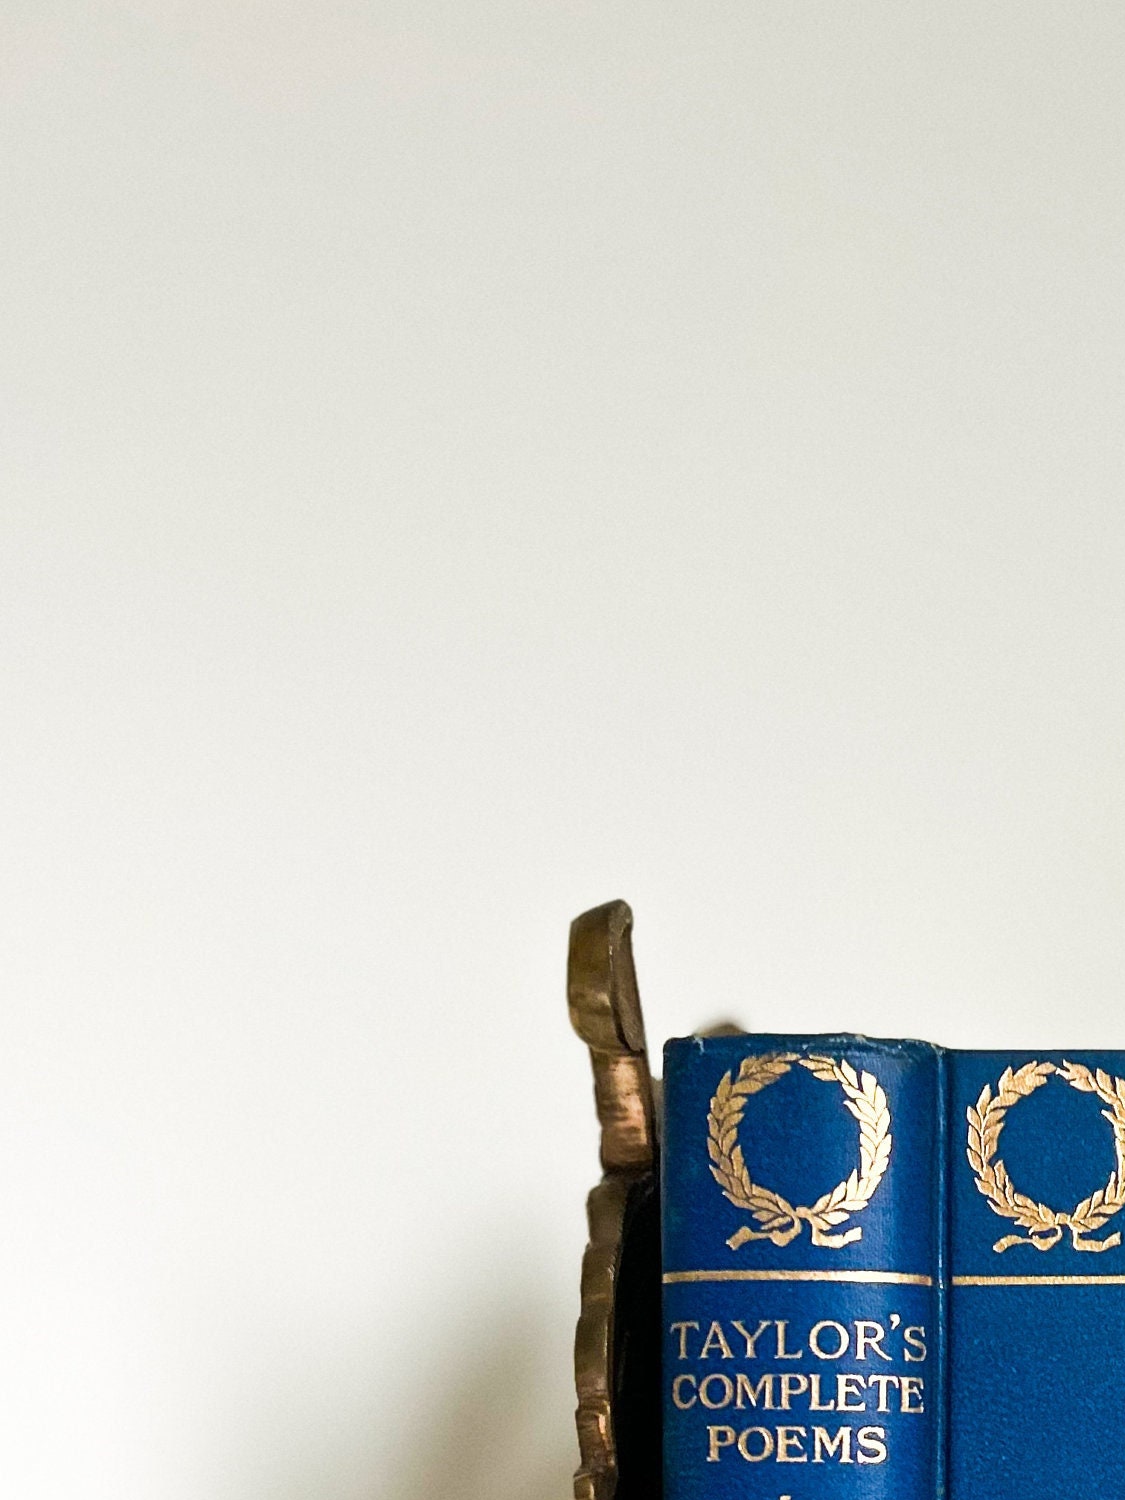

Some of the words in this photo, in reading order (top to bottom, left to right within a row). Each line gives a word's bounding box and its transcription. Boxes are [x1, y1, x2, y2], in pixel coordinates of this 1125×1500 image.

[670, 1313, 928, 1362] TAYLOR'S
[671, 1374, 925, 1414] COMPLETE
[705, 1425, 888, 1465] POEMS
